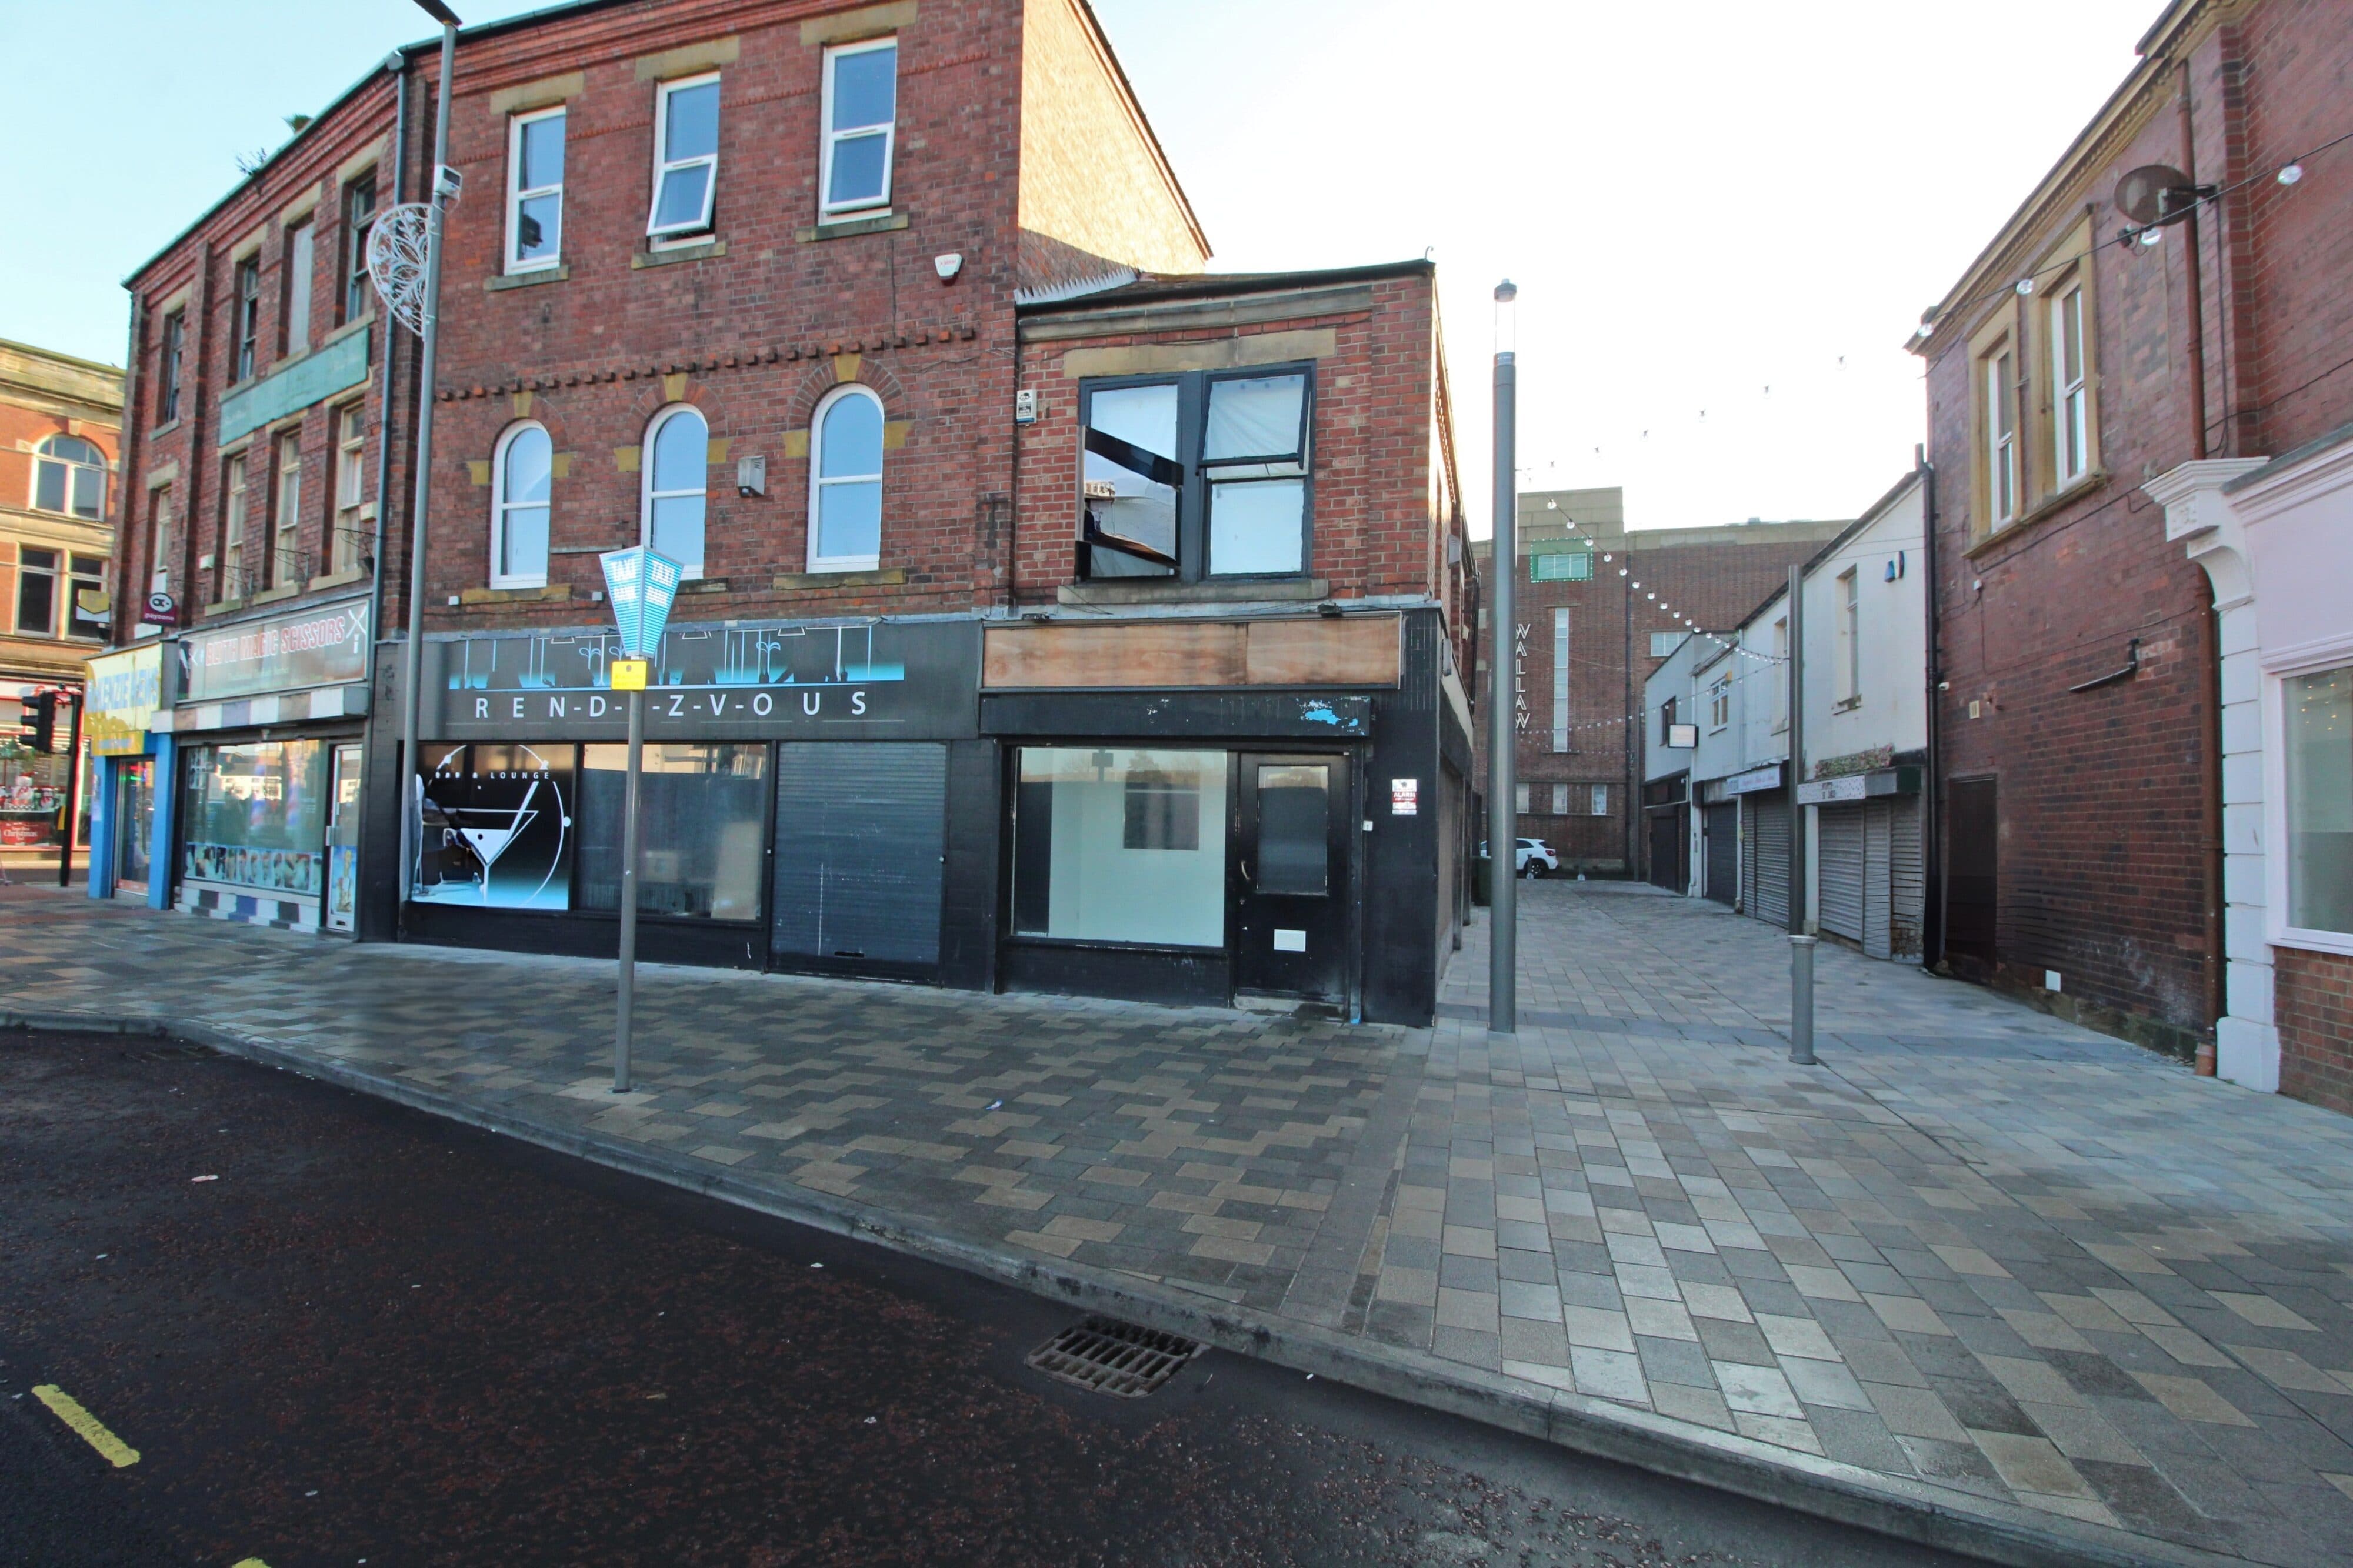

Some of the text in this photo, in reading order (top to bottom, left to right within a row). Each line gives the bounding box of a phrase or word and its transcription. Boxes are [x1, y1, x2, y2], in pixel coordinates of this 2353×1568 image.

[145, 613, 175, 621] payzone
[240, 630, 278, 661] MAGIC
[280, 616, 345, 654] SCISSORS
[1515, 623, 1531, 729] WALLAW
